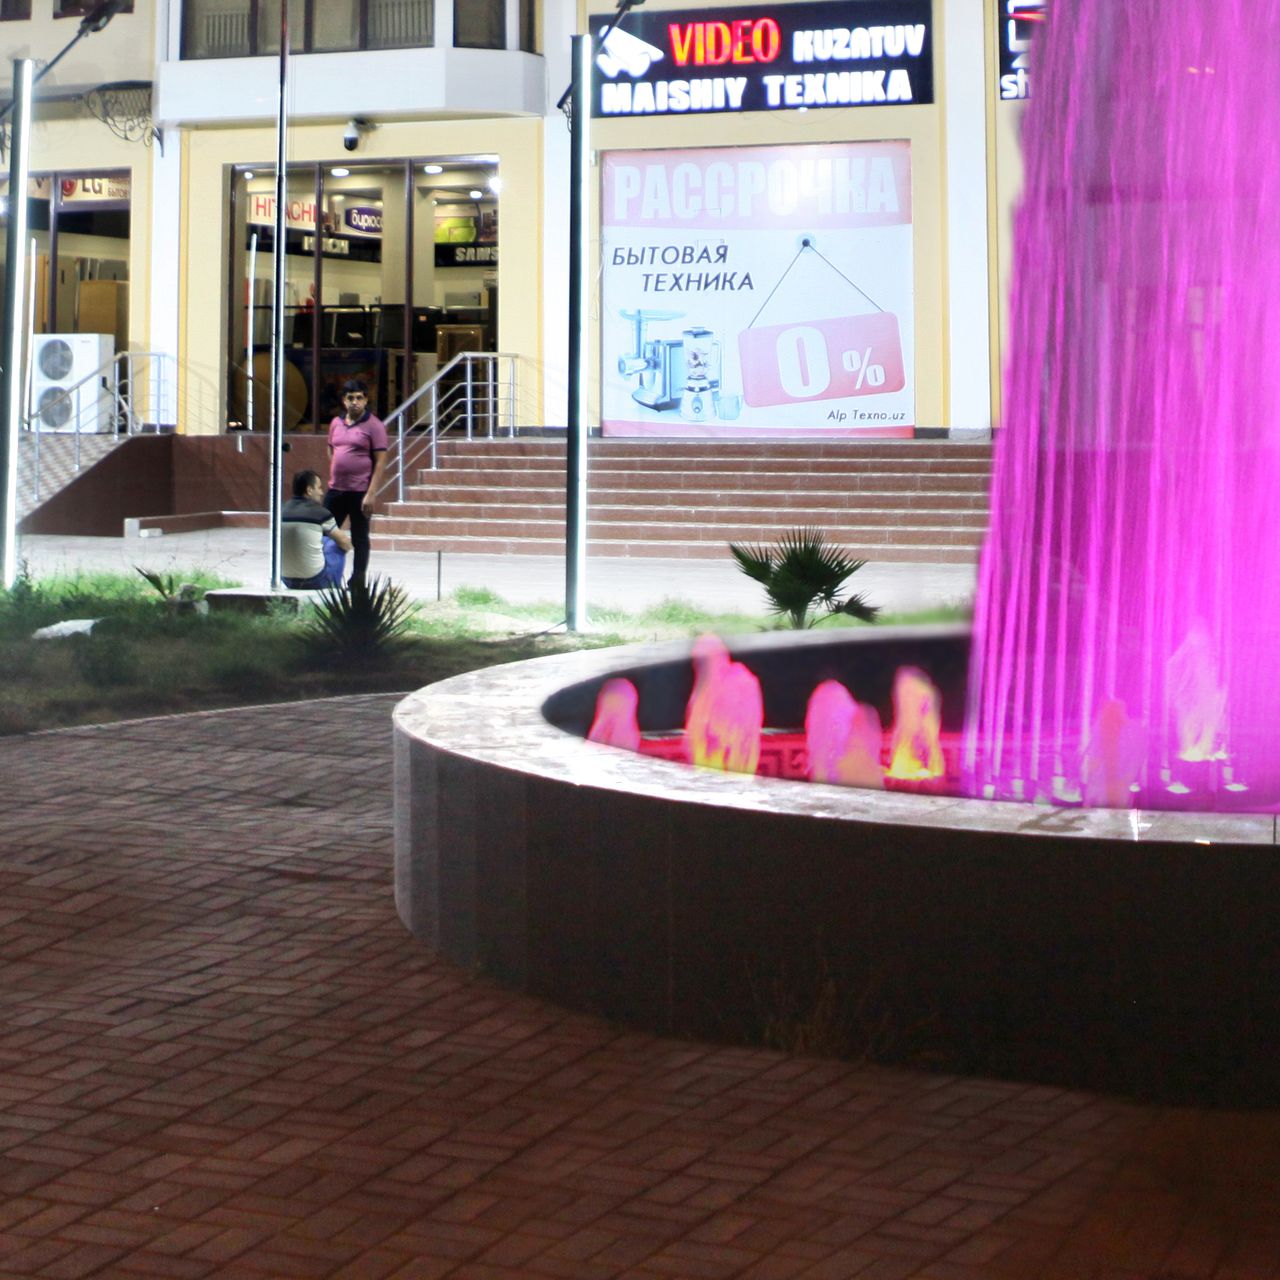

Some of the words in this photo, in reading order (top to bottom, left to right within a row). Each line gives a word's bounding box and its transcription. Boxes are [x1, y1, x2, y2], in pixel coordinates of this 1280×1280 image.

[668, 17, 781, 67] VIDEO
[792, 24, 926, 63] KUZATUV
[600, 76, 748, 114] MAISHIY
[762, 69, 913, 107] TEXNIKA
[613, 156, 900, 220] РАССРОЧКА
[255, 196, 318, 223] HICHI
[612, 245, 729, 266] БЫТОВАЯ
[642, 272, 755, 292] ТЕХНИКА
[827, 409, 847, 422] Alp
[853, 408, 905, 420] Texno.uz
